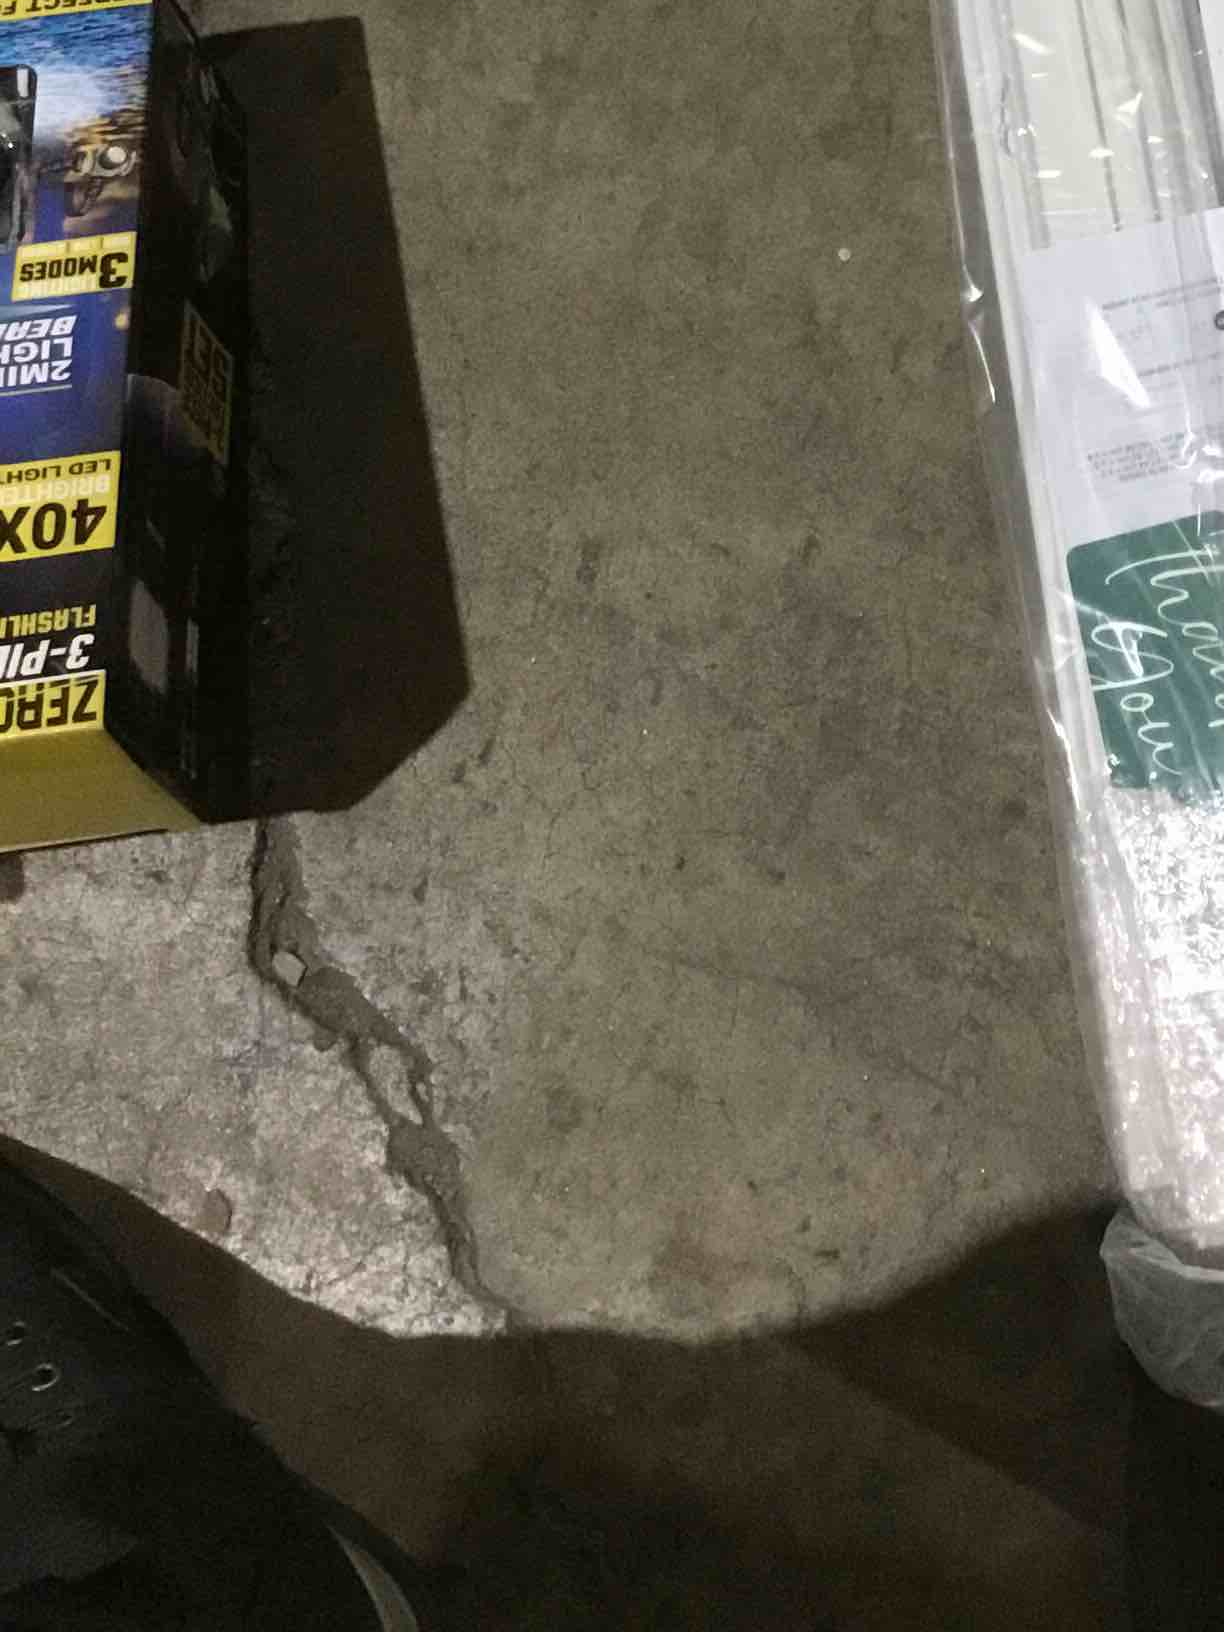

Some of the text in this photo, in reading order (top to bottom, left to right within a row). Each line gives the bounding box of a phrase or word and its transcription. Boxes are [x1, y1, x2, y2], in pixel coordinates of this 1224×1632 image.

[0, 0, 17, 16] F
[20, 255, 97, 282] MODES
[99, 252, 128, 288] 3
[0, 315, 77, 344] BEA
[0, 359, 72, 387] 2MI
[69, 459, 112, 475] LED
[0, 498, 107, 553] 40X
